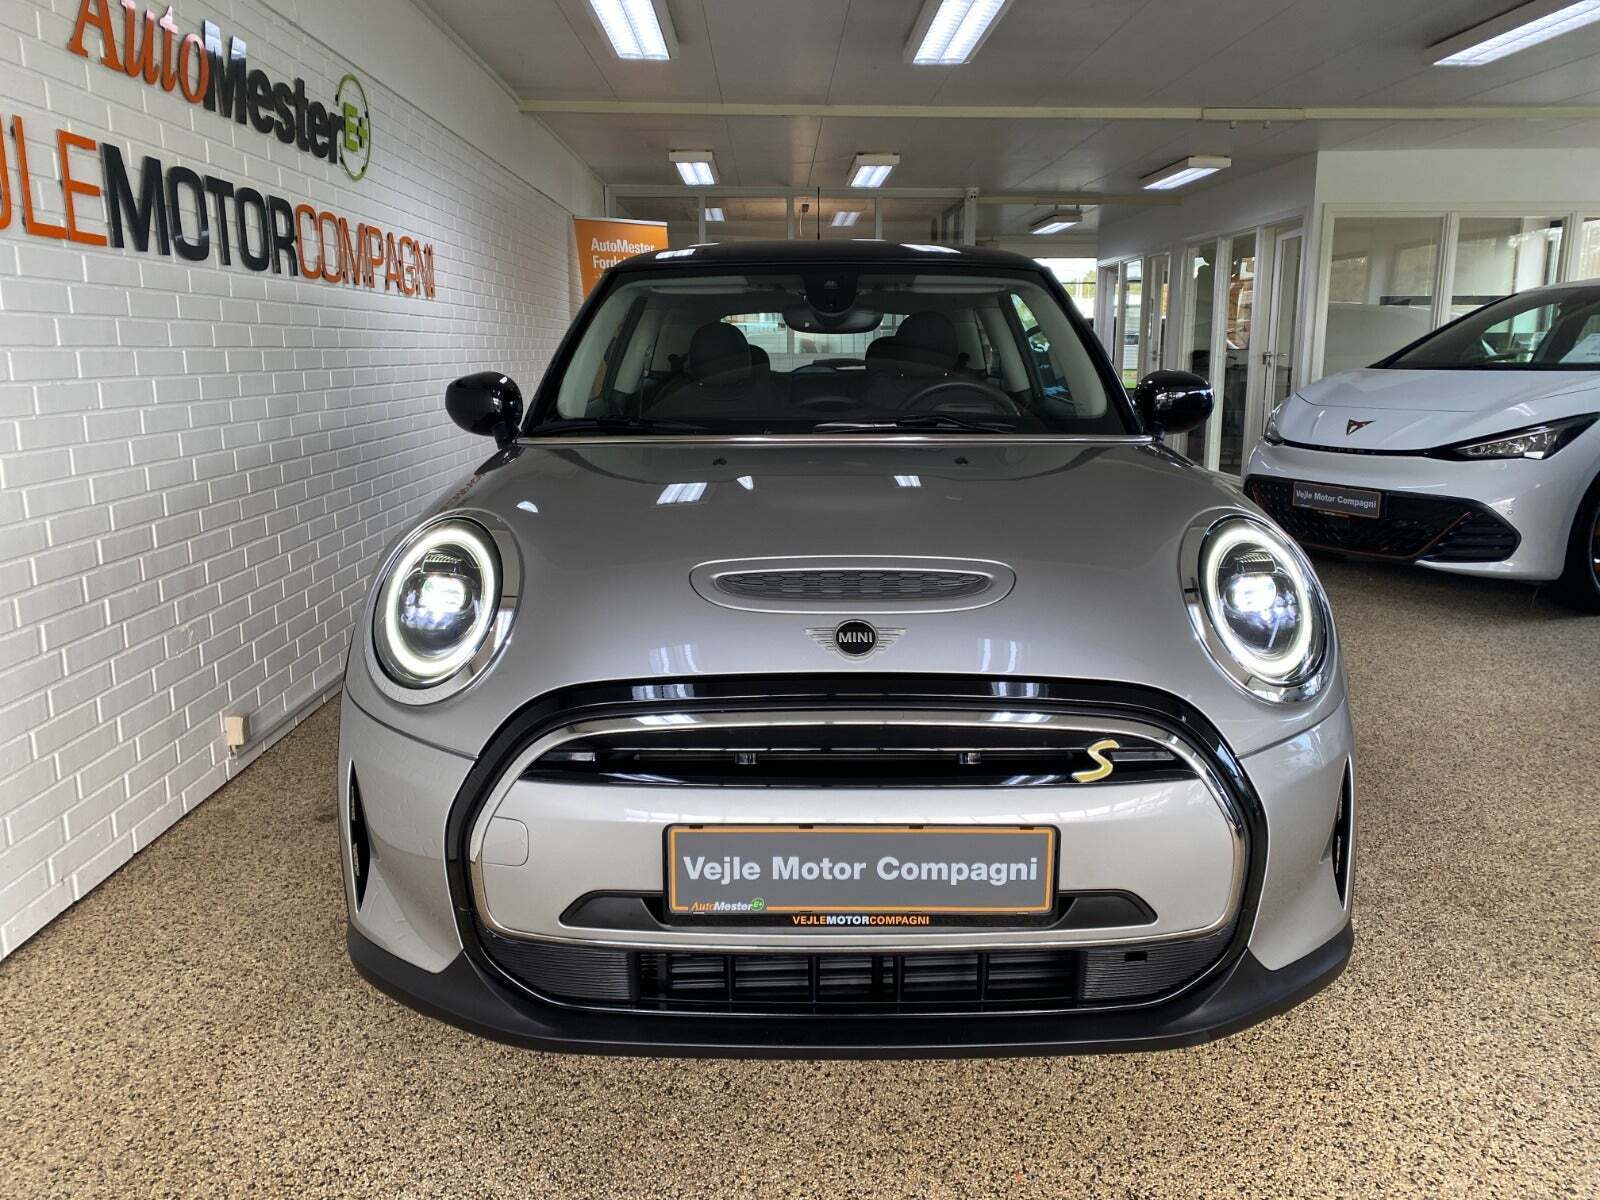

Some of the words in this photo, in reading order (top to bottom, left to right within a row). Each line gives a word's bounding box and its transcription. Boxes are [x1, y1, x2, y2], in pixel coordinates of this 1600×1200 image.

[591, 237, 655, 254] AutoMester
[1296, 489, 1313, 500] Vejle
[1314, 492, 1336, 503] Motor
[1337, 495, 1377, 509] Compagni
[838, 631, 873, 643] MINI
[1072, 739, 1120, 783] S
[683, 856, 761, 885] Vejle
[772, 857, 866, 881] Motor
[876, 856, 1038, 886] Compagni
[792, 915, 930, 926] VEJLEMOTORCOMPAGNI
